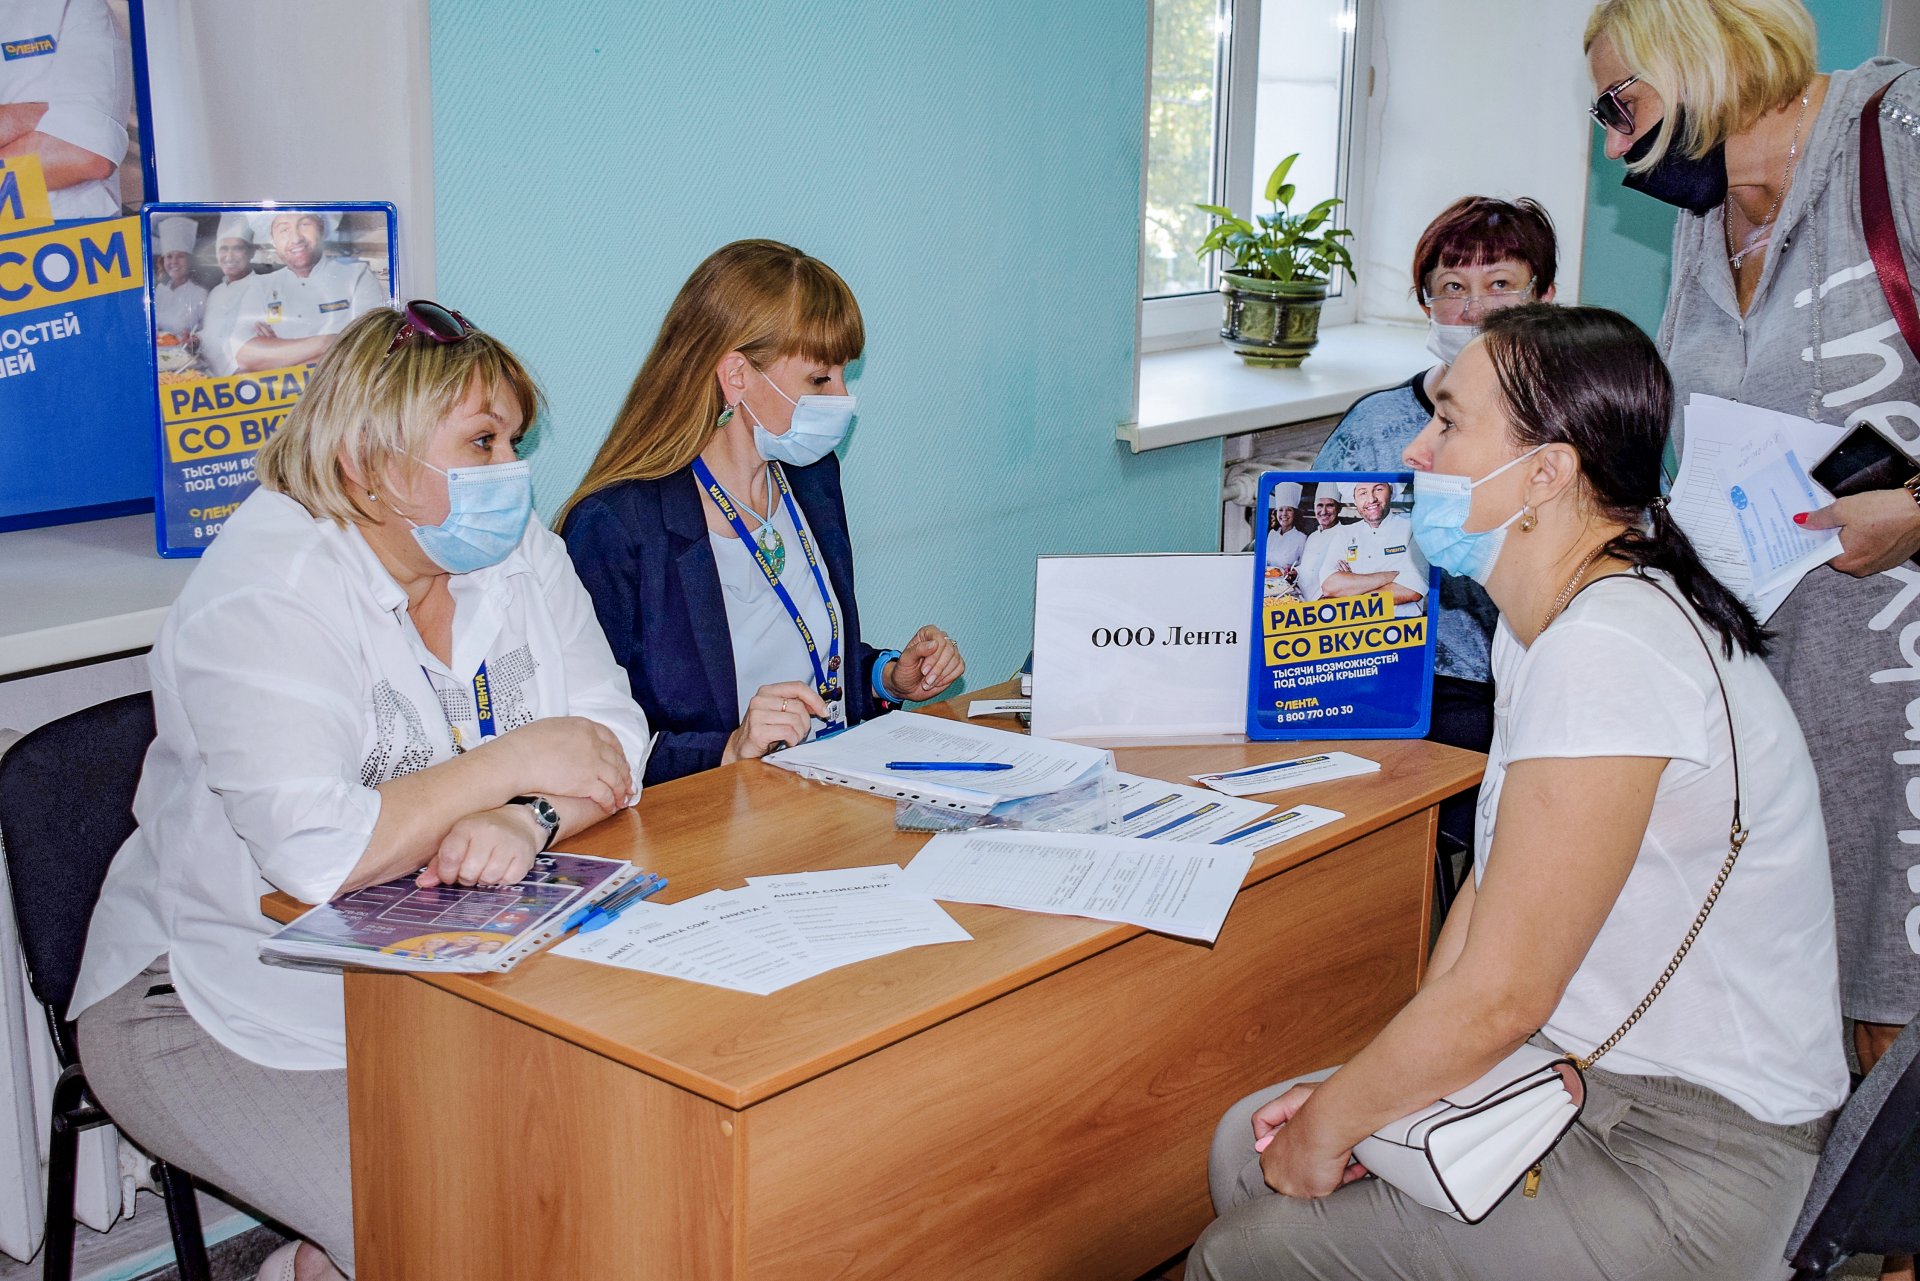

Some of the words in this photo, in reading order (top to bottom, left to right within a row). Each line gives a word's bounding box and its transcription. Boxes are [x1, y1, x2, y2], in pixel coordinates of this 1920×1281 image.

[0, 312, 81, 352] ОСТЕЙ
[179, 424, 231, 454] СО
[240, 414, 292, 445] ВК
[182, 460, 238, 479] ТЫСЯЧИ
[185, 477, 216, 492] ПОД
[218, 470, 257, 487] ОДНО
[202, 502, 240, 521] ЛЕНТ
[709, 484, 734, 513] ЛЕНТА
[194, 527, 203, 538] 8
[206, 524, 223, 536] 80
[755, 549, 776, 578] ЛЕНТА
[801, 535, 817, 567] ЛЕНТА
[1271, 592, 1384, 630] РАБОТАЙ
[795, 615, 813, 645] ЛЕНТА
[1091, 626, 1155, 648] ООО
[1162, 625, 1238, 646] Лента
[1273, 637, 1311, 660] СО
[1319, 622, 1423, 655] ВКУСОМ
[1272, 665, 1314, 679] ТЫСЯЧИ
[1315, 652, 1399, 673] ВОЗМОЖНОСТЕЙ
[1274, 679, 1296, 689] ПОД
[1297, 672, 1334, 686] ОДНОЙ
[1336, 665, 1378, 680] КРЫШЕЙ
[475, 673, 491, 711] ЛЕНТА
[1284, 697, 1319, 711] ЛЕНТА
[1277, 714, 1284, 723] 8
[1286, 711, 1305, 722] 800
[1307, 708, 1323, 719] 770
[1326, 706, 1339, 716] 00
[1340, 704, 1353, 714] 30
